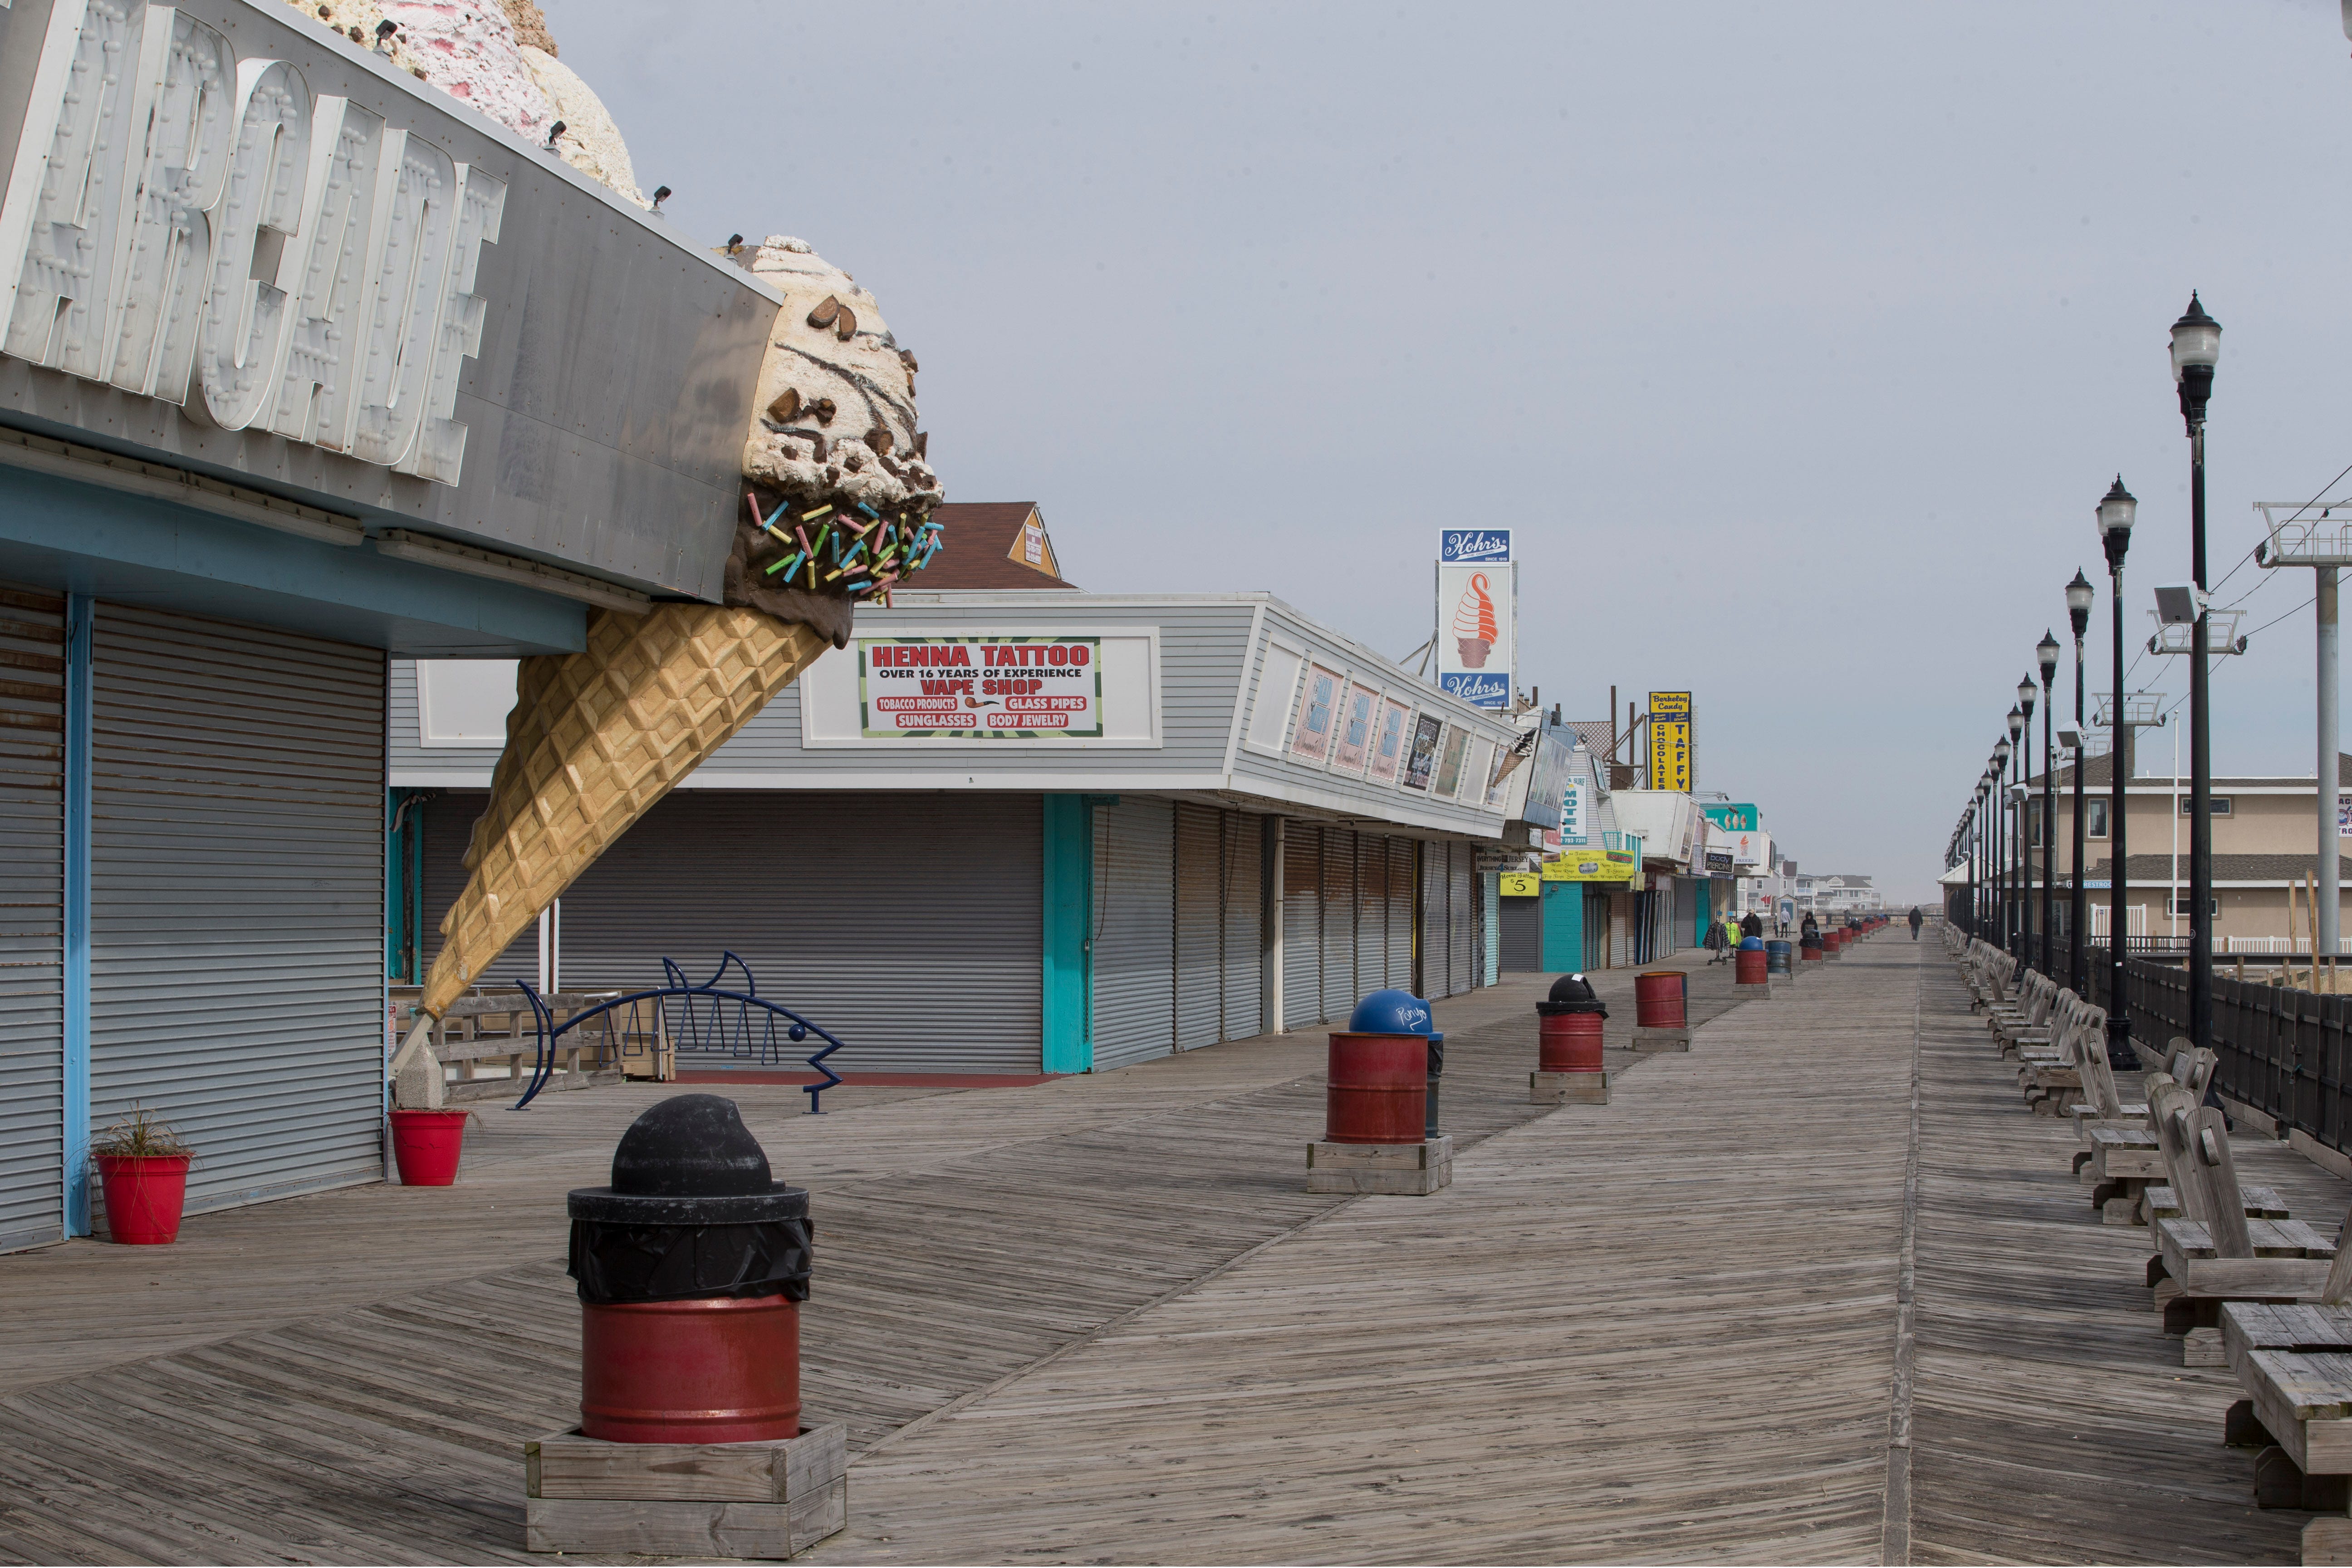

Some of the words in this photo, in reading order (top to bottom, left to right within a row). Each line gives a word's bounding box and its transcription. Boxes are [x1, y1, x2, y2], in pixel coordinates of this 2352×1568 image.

[0, 0, 507, 486] ARCADE
[1445, 532, 1500, 556] Kohr's
[872, 646, 971, 667] HENNA
[980, 646, 1089, 666] TATTOO
[879, 670, 915, 678] OVER
[937, 669, 979, 677] YEARS
[983, 669, 1000, 677] OF
[1004, 669, 1082, 677] EXPERIENCE
[920, 680, 975, 695] VAPE
[982, 679, 1043, 695] SHOP
[879, 699, 915, 710] TOBACCO
[916, 699, 956, 710] PRODUCTS
[1009, 698, 1049, 709] GLASS
[1051, 698, 1084, 709] PIPES
[898, 715, 974, 726] SUNGLASSES
[990, 715, 1019, 726] BODY
[1021, 715, 1066, 726] JEWELRY
[1657, 724, 1666, 790] CHOCOLATES
[1675, 724, 1685, 789] TAFFY
[1574, 778, 1585, 786] SURF
[1563, 790, 1578, 834] MOTEL
[1710, 854, 1730, 863] body
